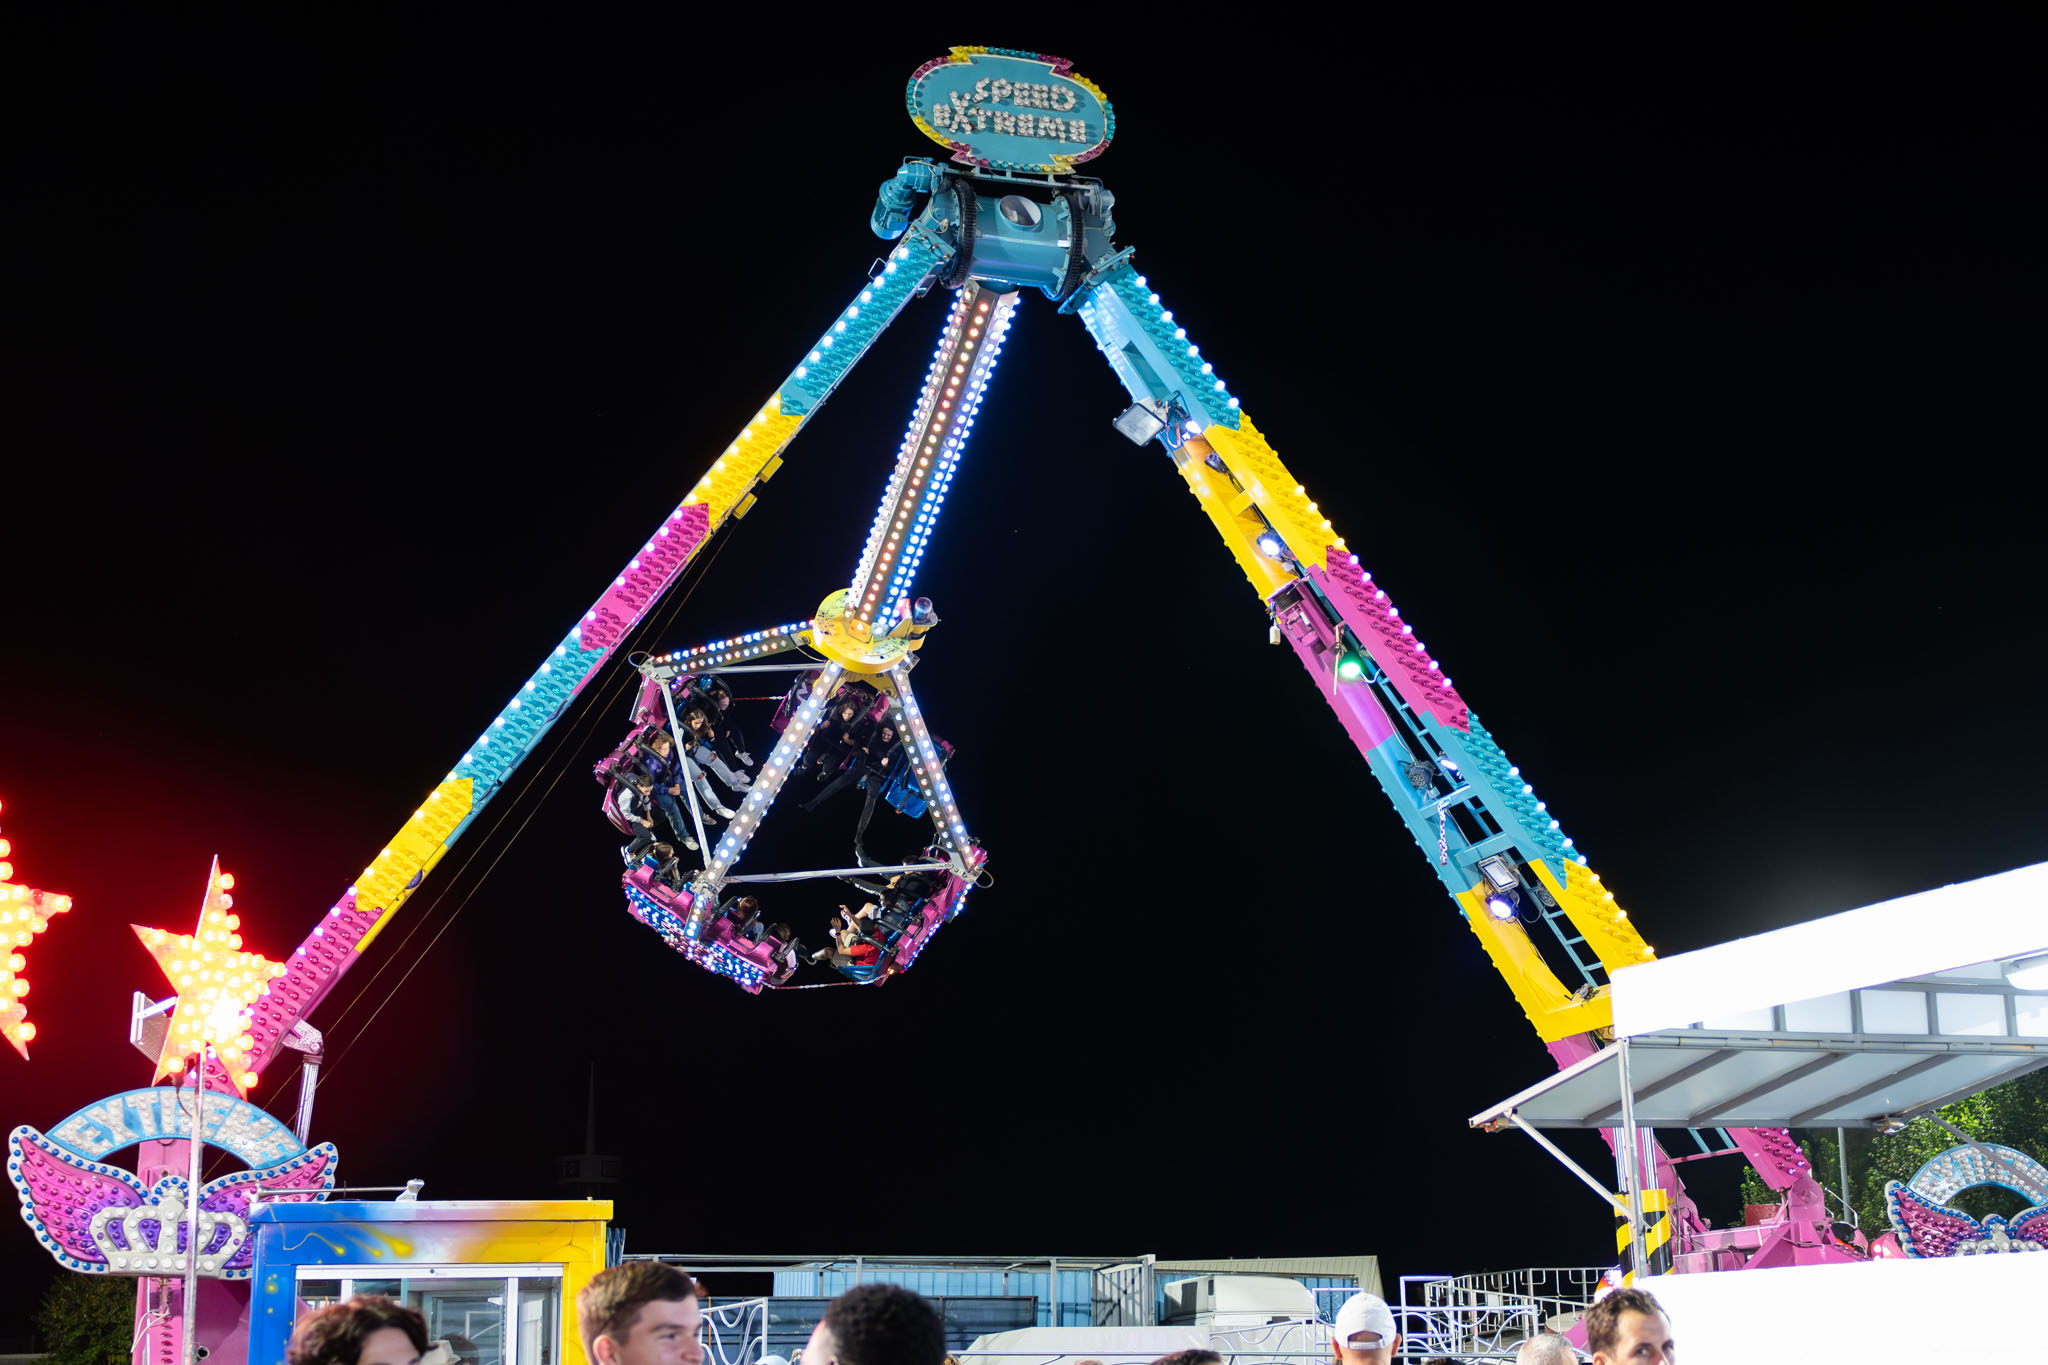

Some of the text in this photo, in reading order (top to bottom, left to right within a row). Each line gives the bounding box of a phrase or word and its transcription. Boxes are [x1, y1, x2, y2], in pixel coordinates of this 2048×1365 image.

[933, 91, 1086, 143] EXTREME
[972, 77, 1076, 111] SPEED
[53, 1090, 301, 1168] EXTREME
